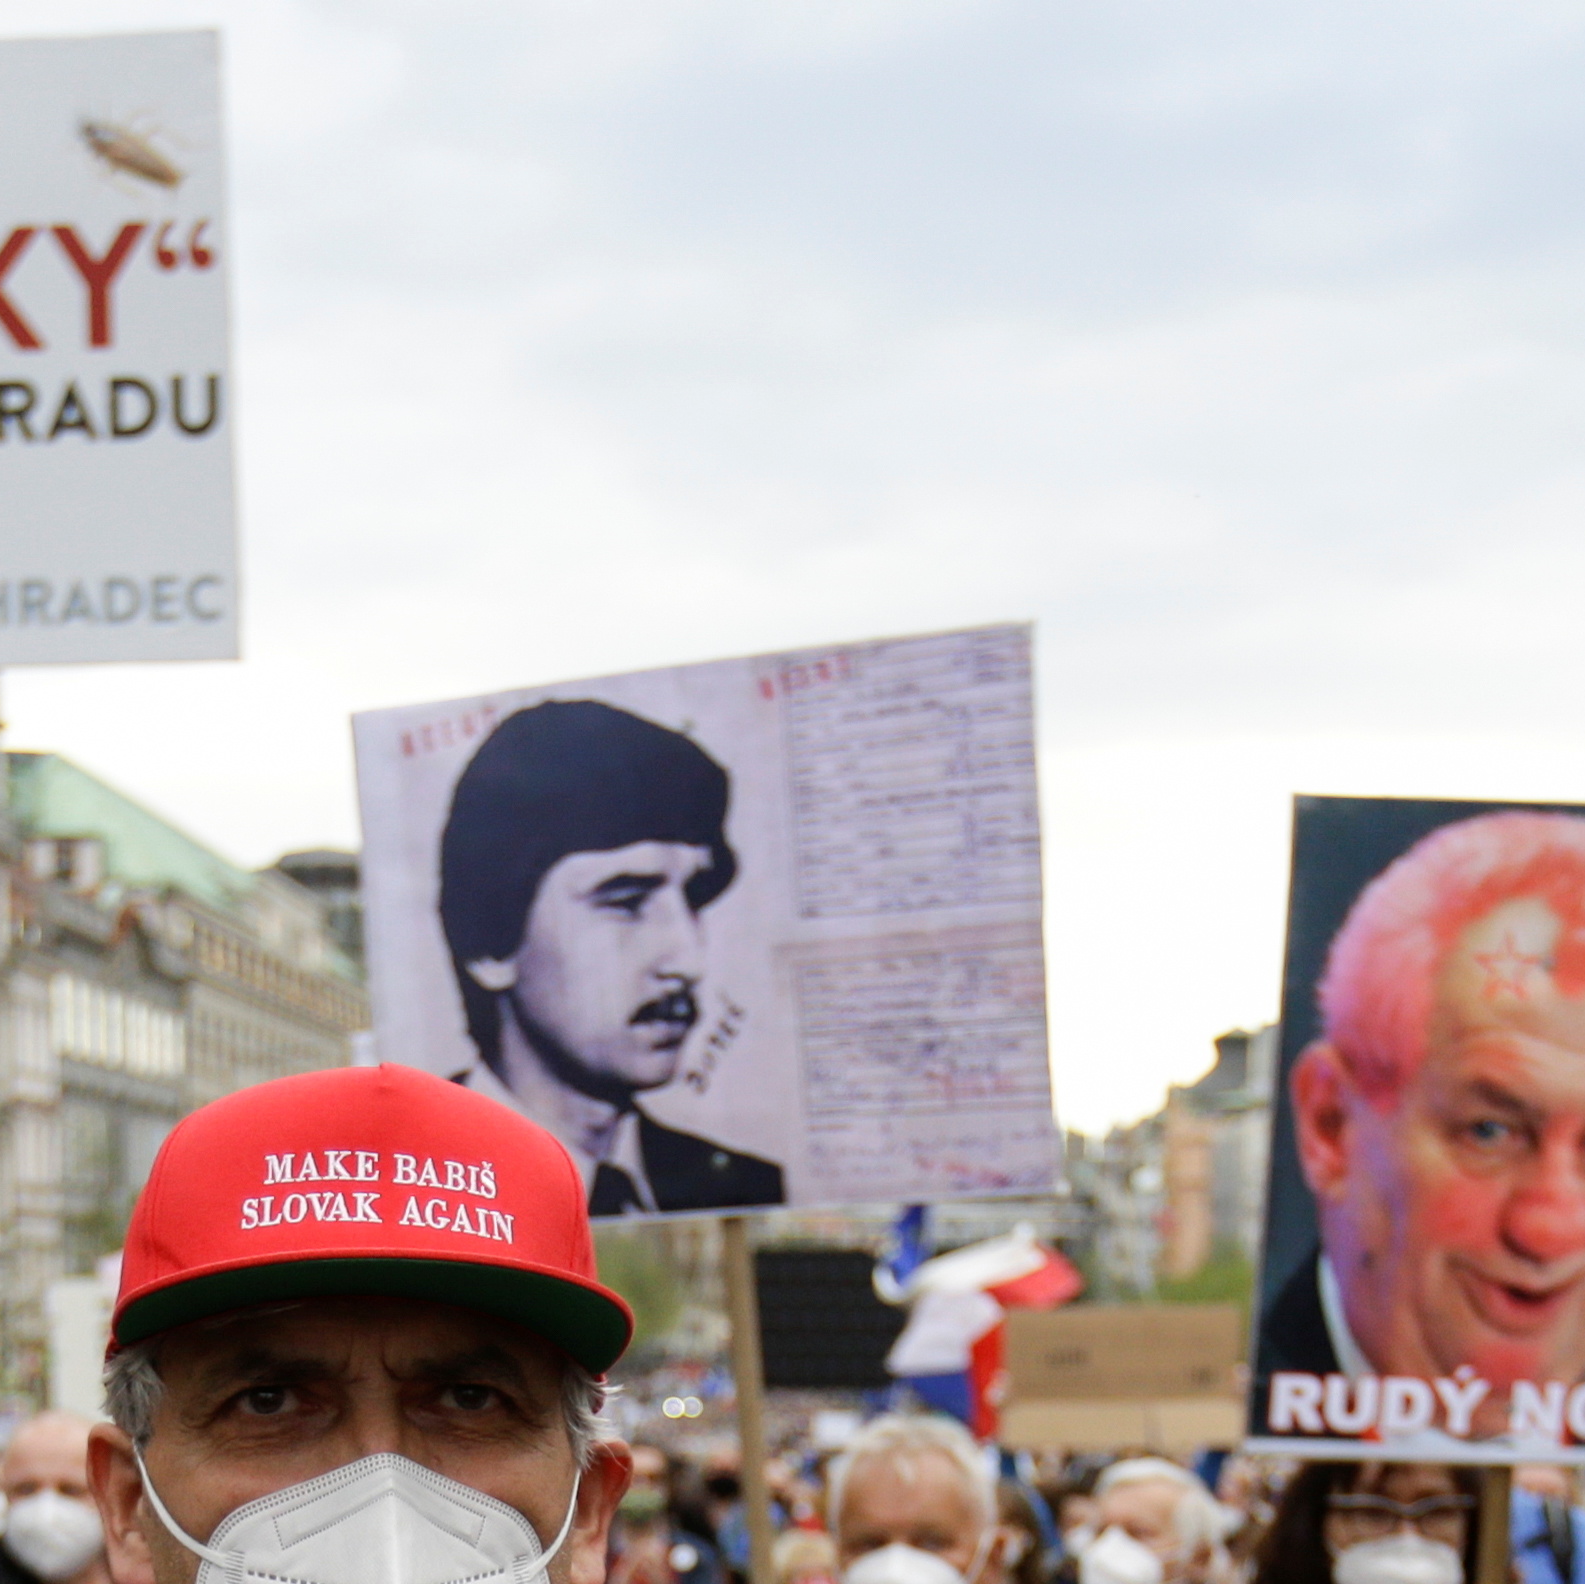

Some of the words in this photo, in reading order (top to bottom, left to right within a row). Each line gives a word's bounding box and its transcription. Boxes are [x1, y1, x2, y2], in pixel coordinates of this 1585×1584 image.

[263, 1150, 380, 1185] MAKE
[392, 1153, 498, 1199] BABIŠ
[241, 1191, 383, 1230] SLOVAK
[399, 1196, 515, 1245] AGAIN
[1268, 1363, 1491, 1437] RUDÝ
